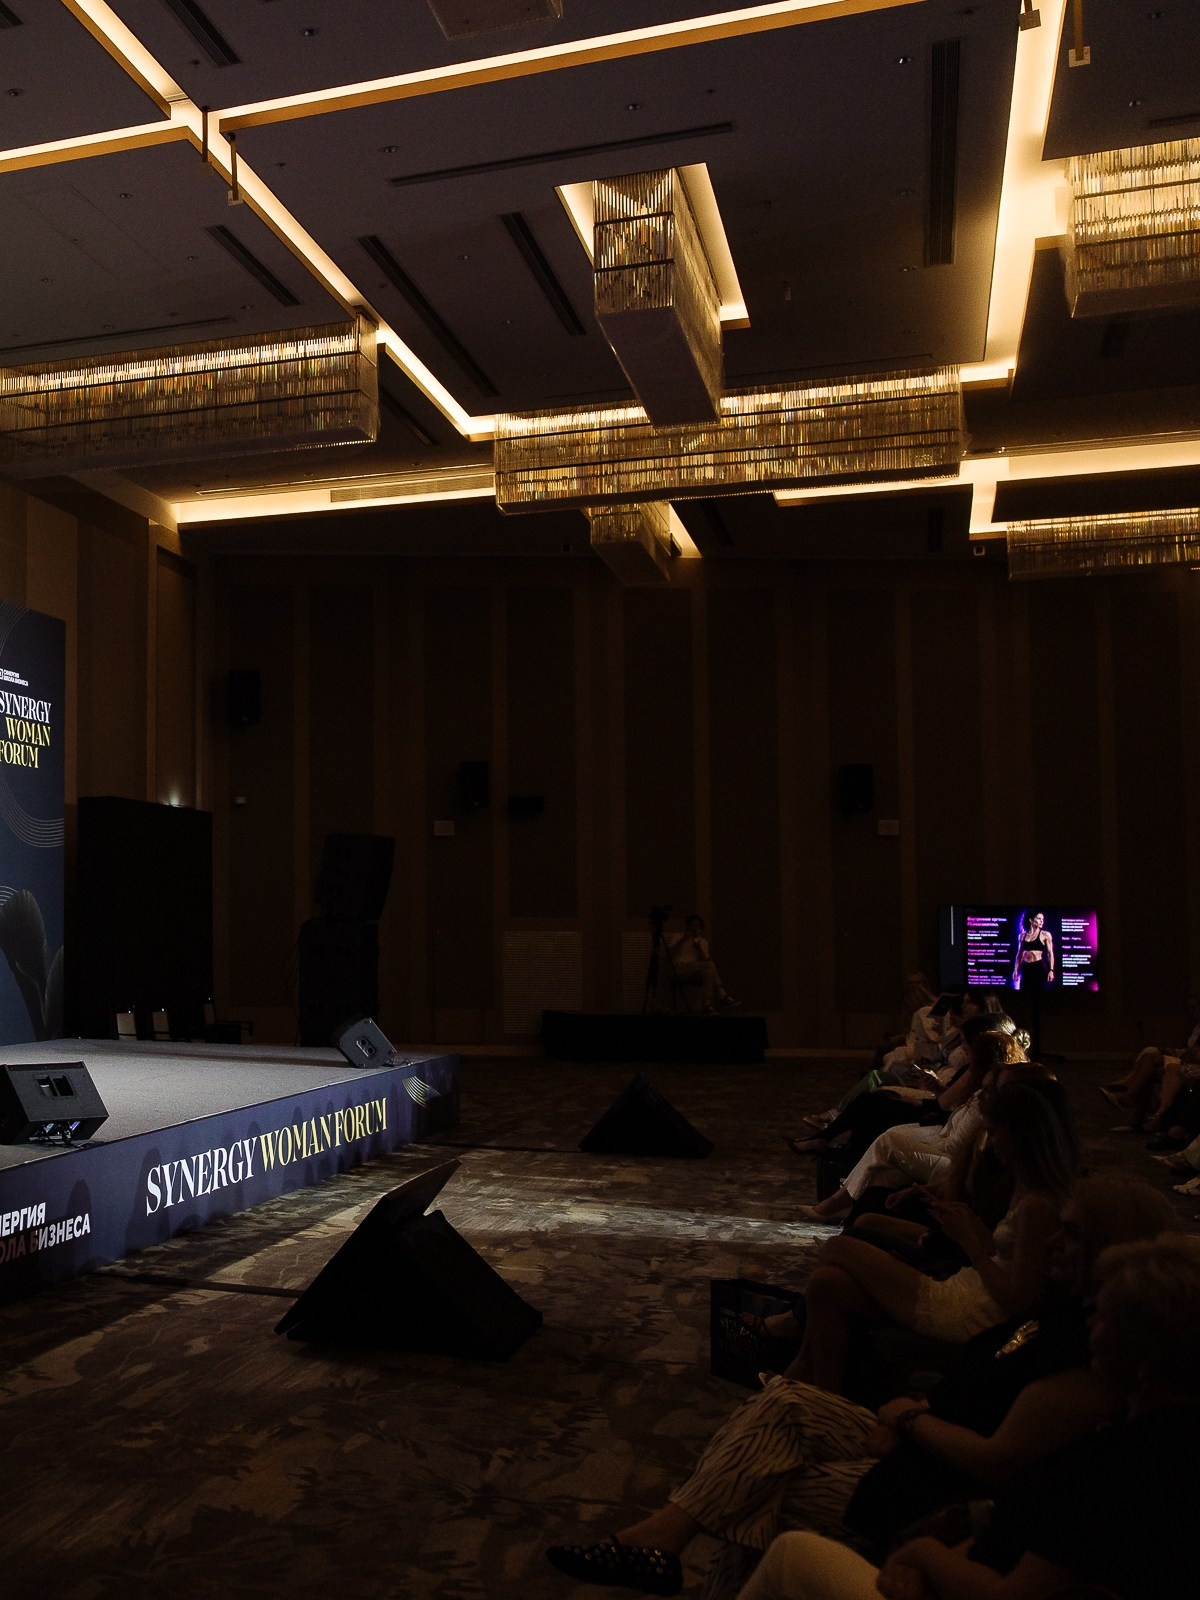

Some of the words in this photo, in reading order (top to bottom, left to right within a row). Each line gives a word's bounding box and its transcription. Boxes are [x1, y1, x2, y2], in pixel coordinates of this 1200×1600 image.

[5, 716, 50, 747] WOMAN
[146, 1137, 258, 1217] SYNERGY
[259, 1114, 332, 1172] WOMAN
[335, 1097, 387, 1148] FORUM
[30, 1213, 91, 1253] БИЗНЕСА
